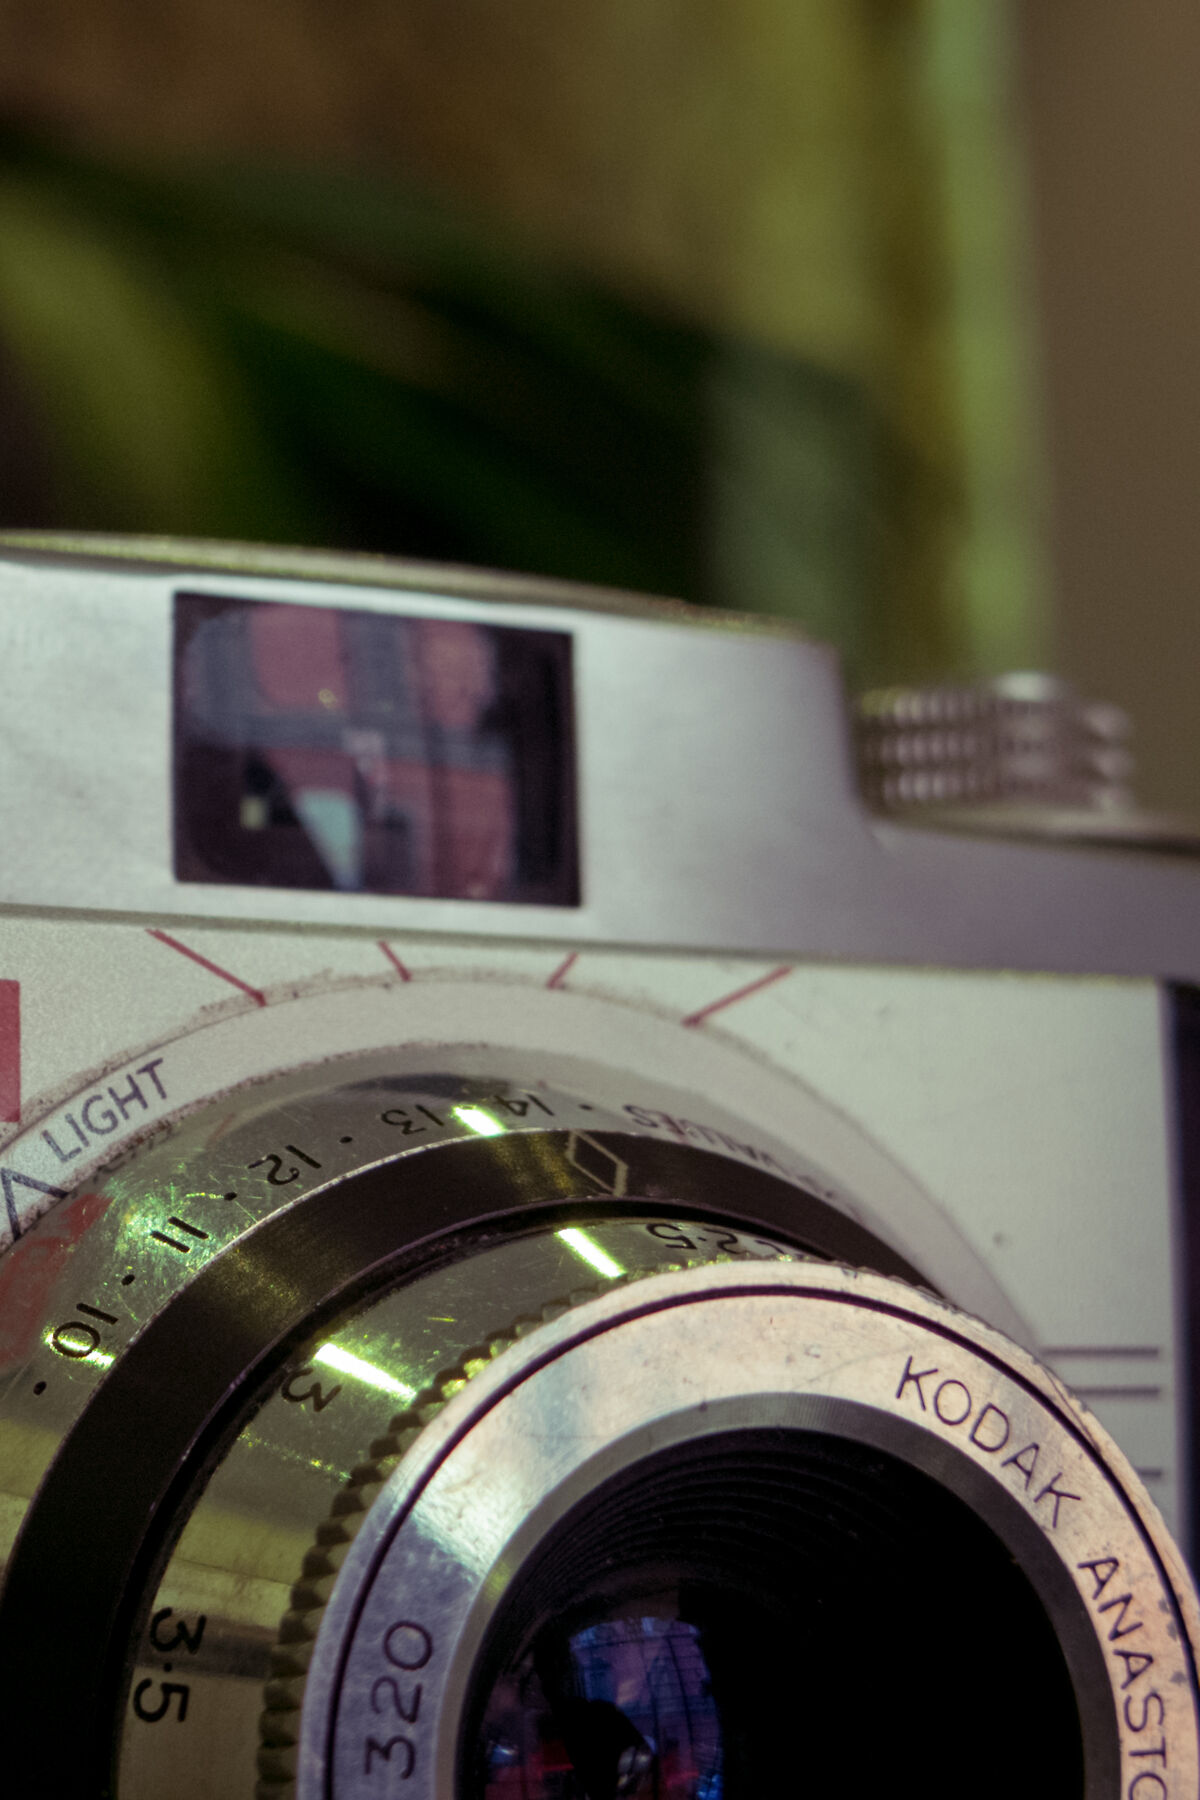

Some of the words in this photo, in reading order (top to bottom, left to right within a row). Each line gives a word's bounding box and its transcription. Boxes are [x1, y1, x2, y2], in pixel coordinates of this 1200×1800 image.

[41, 1058, 169, 1163] LIGHT
[380, 1104, 446, 1136] 13
[248, 1144, 323, 1186] 12
[150, 1216, 209, 1254] 11
[51, 1302, 119, 1359] 10
[281, 1367, 343, 1414] 3
[895, 1355, 1082, 1529] KODAK
[363, 1619, 433, 1780] 320
